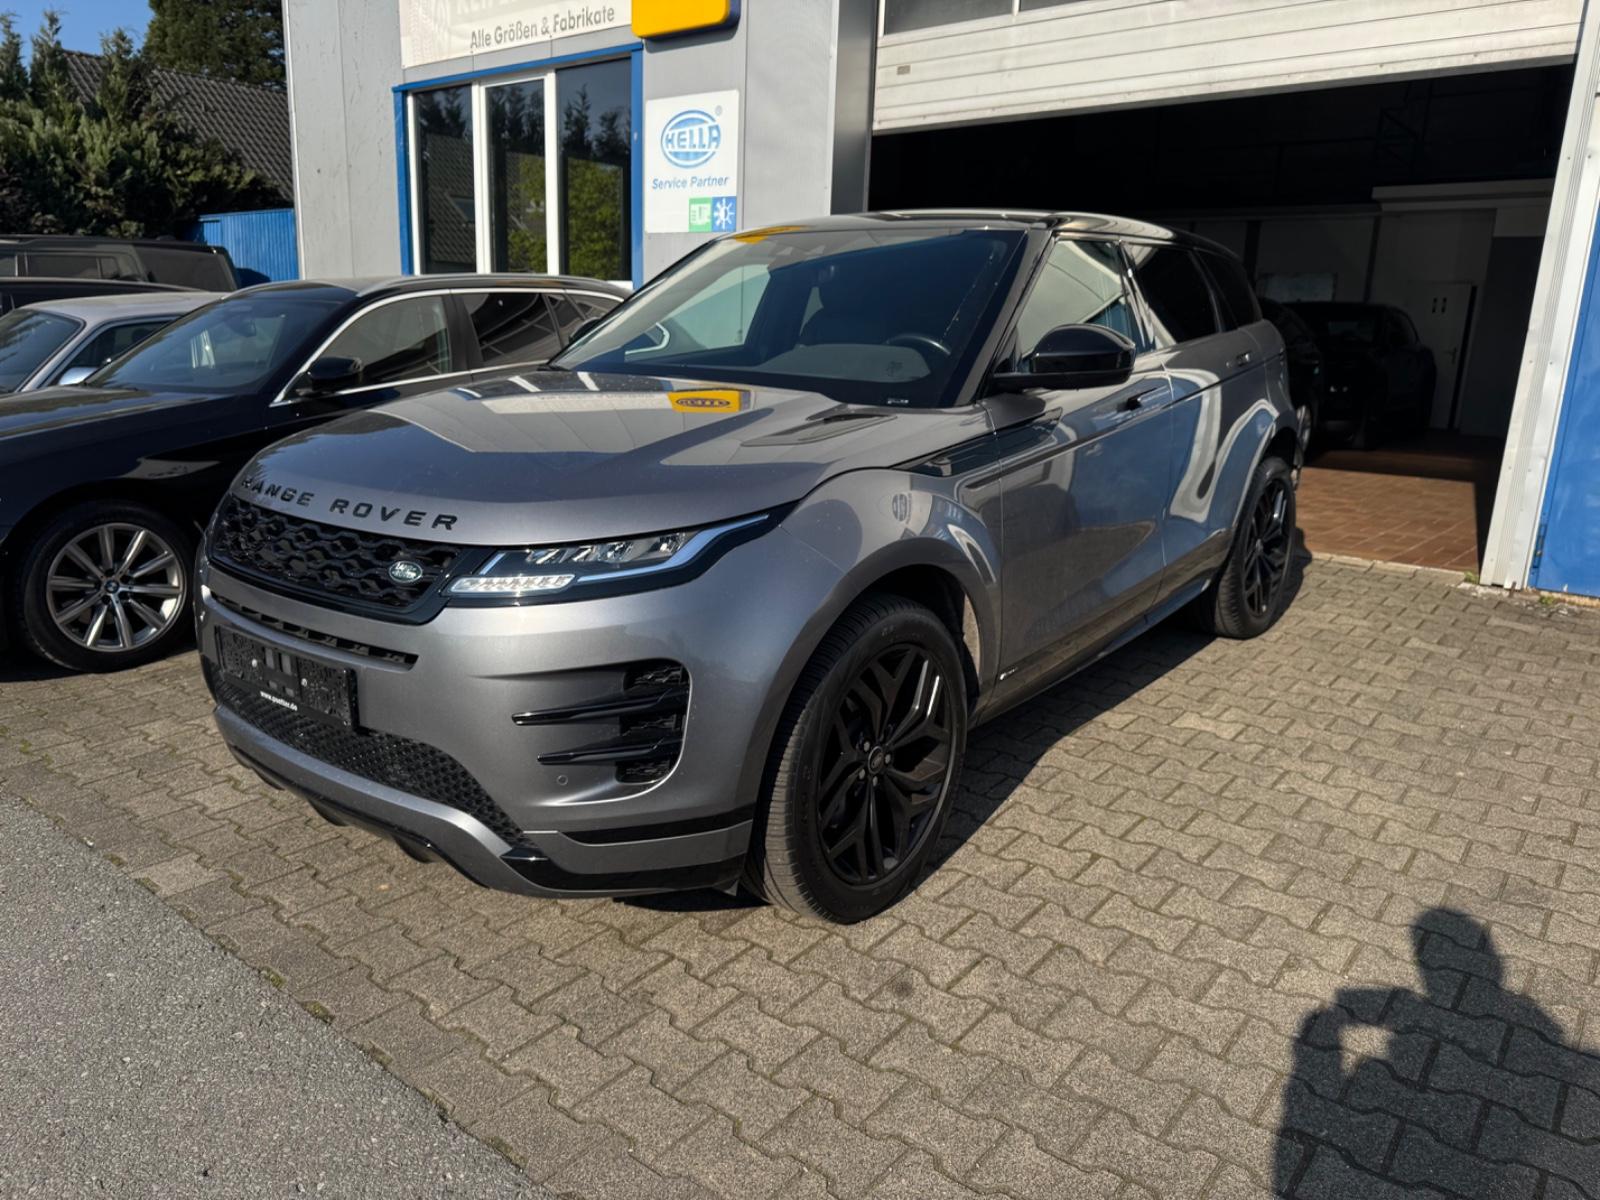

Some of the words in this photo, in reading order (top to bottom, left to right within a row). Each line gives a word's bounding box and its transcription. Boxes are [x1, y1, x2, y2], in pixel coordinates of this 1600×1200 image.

[470, 31, 491, 49] Alle
[495, 22, 538, 44] Größen
[541, 17, 551, 34] &
[553, 7, 615, 33] Fabrikate
[665, 124, 721, 150] HELLA
[652, 178, 688, 190] Service
[690, 175, 728, 188] Partner
[242, 477, 315, 507] RANGE
[328, 498, 458, 531] ROVER
